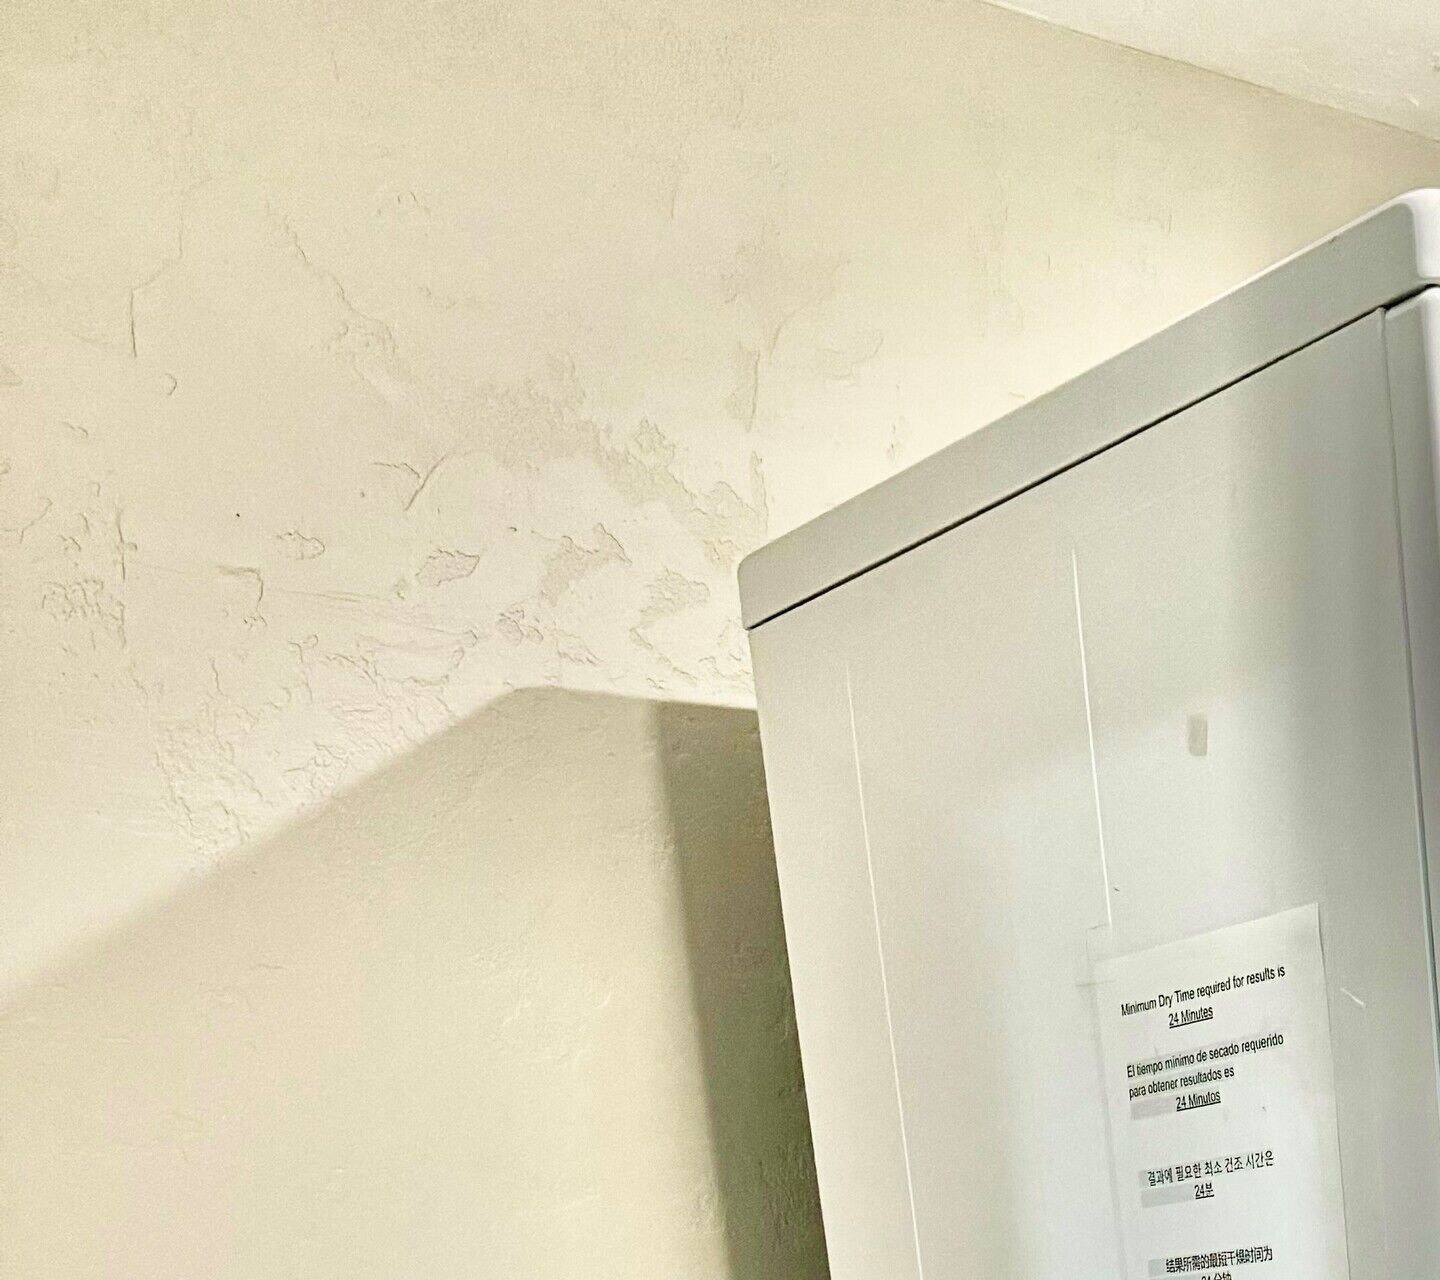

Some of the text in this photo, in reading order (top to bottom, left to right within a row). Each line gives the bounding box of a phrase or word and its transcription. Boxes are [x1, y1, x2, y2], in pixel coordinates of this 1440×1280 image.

[1121, 965, 1285, 1016] Minimum Dry Time required for results is
[1169, 1006, 1213, 1027] 24 Minutes
[1127, 1064, 1135, 1078] El
[1137, 1061, 1163, 1076] tiempo
[1196, 1050, 1207, 1063] de
[1209, 1043, 1239, 1059] secado
[1242, 1033, 1284, 1054] requerido
[1129, 1066, 1234, 1101] para obtener resultados es
[1176, 1090, 1221, 1111] 24 Minutos
[1148, 1151, 1274, 1186] 결과에 필요한 최소 건조 시간은
[1195, 1182, 1214, 1199] 24분
